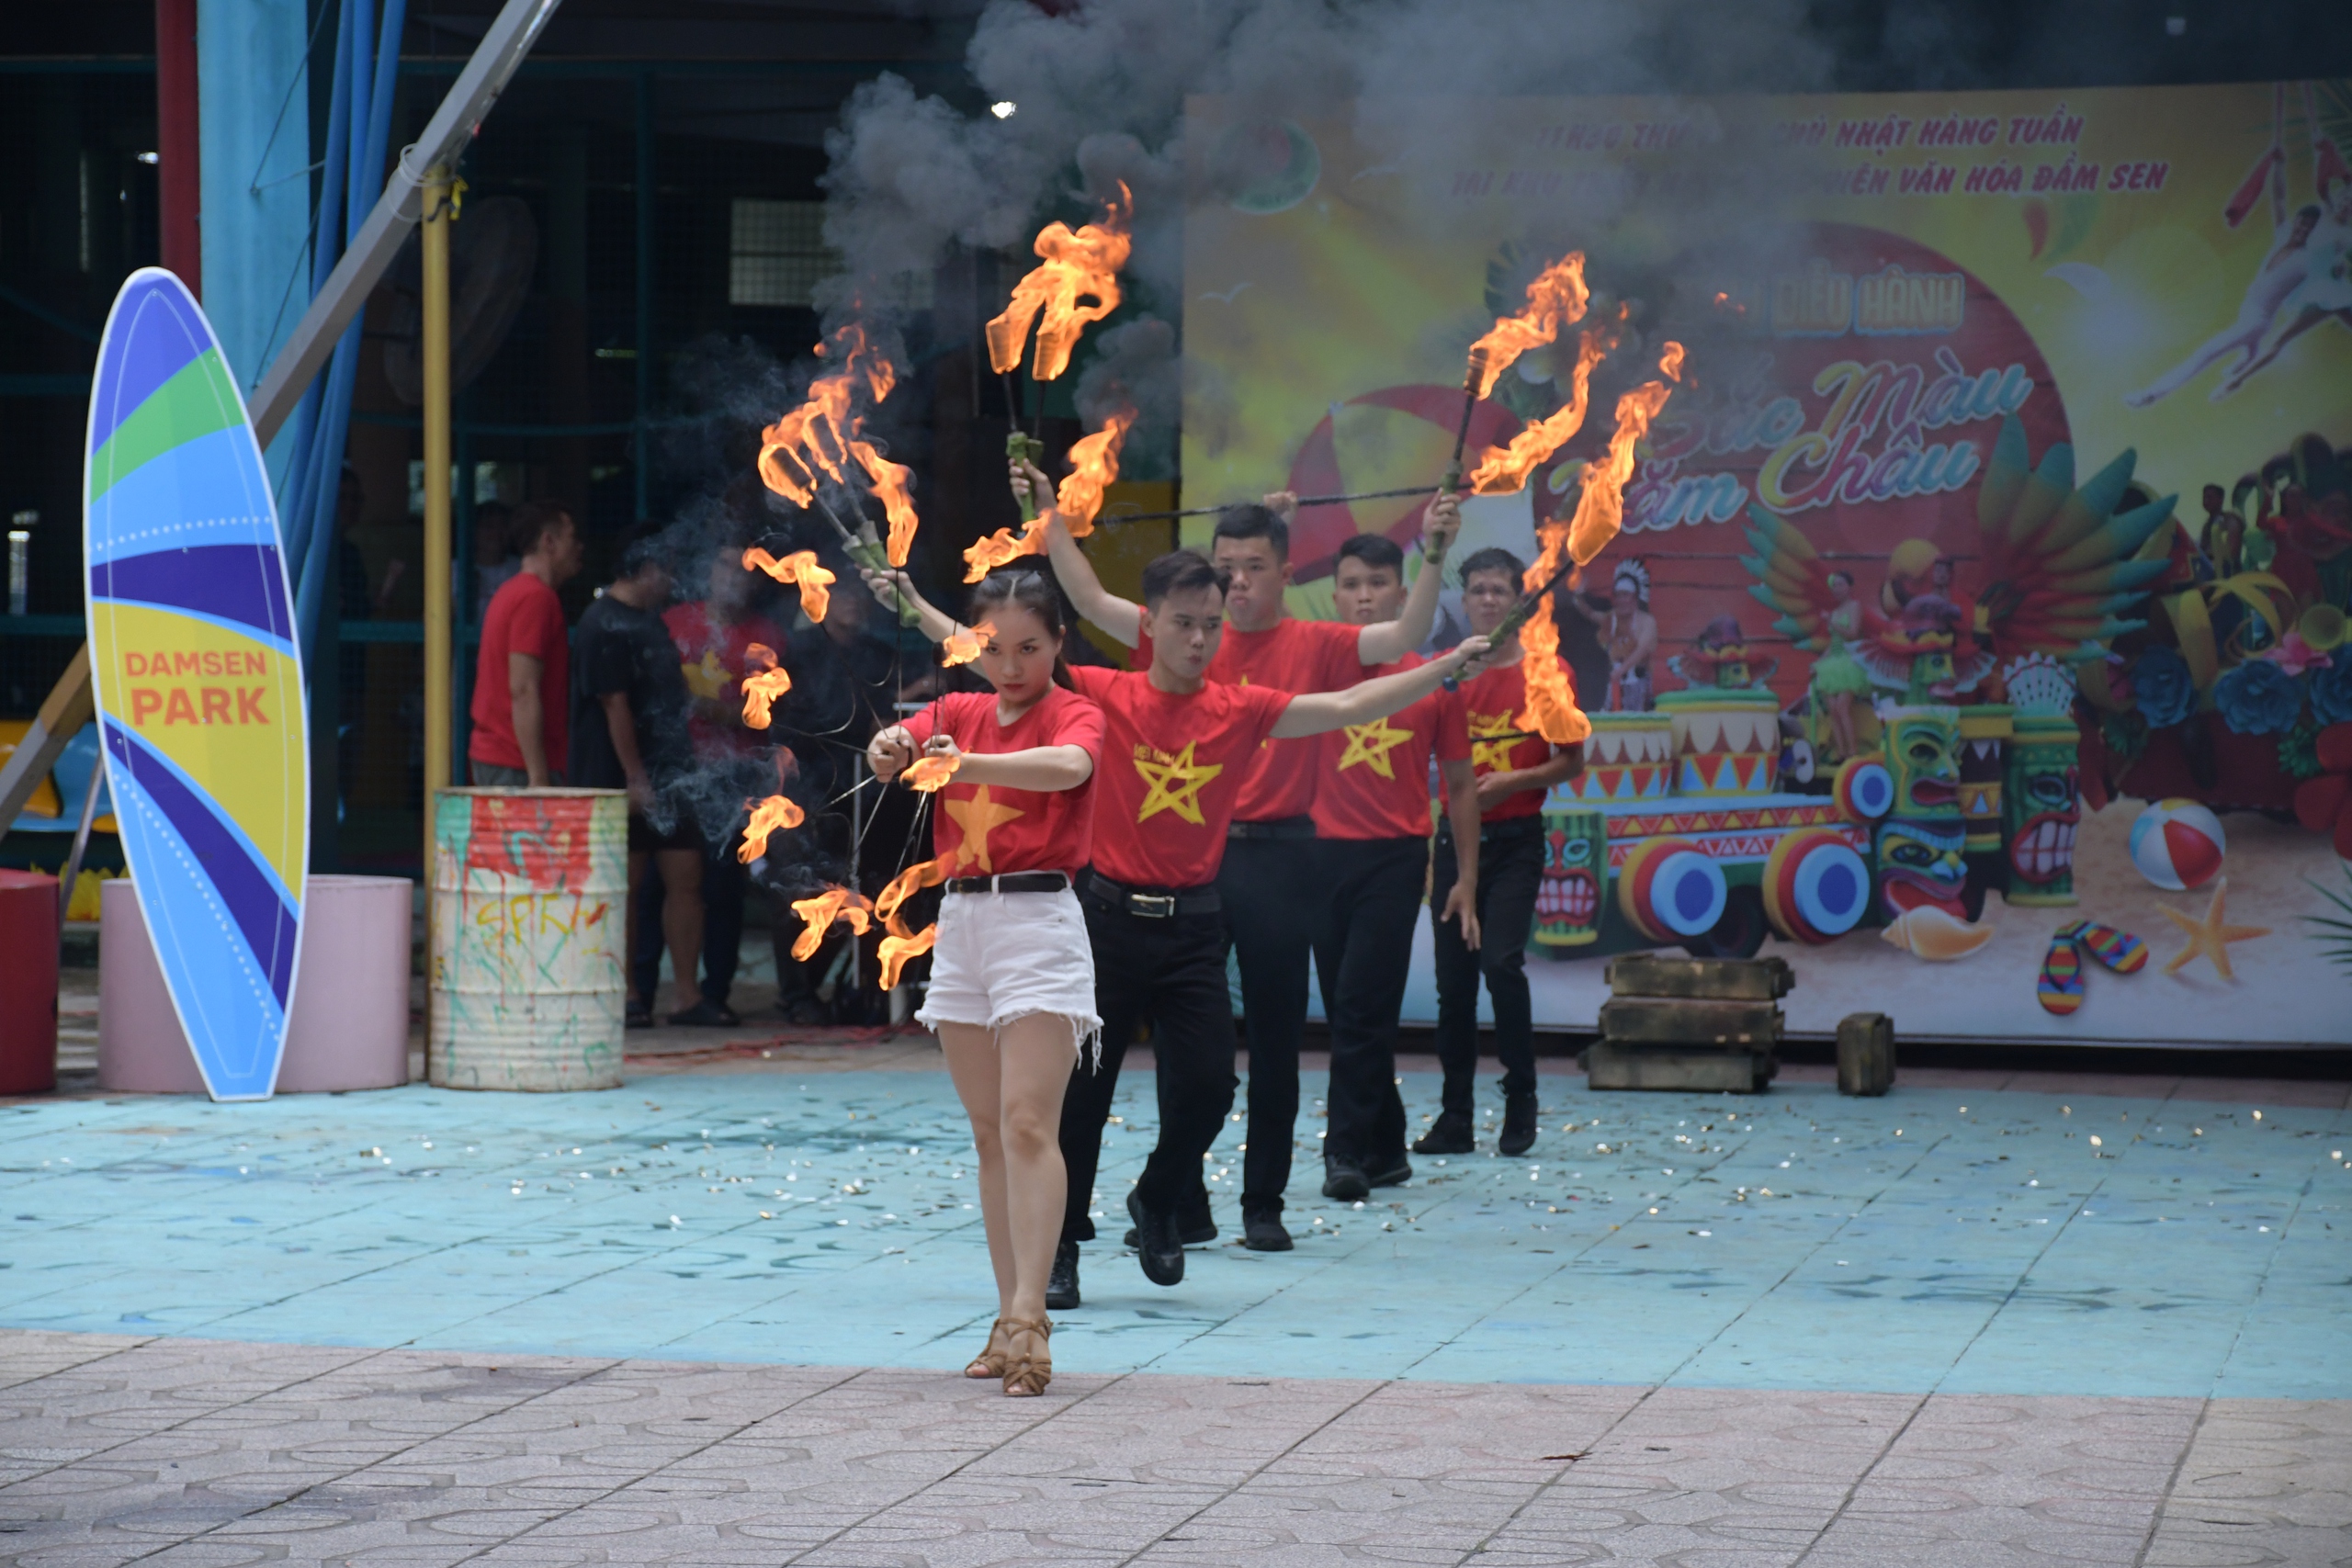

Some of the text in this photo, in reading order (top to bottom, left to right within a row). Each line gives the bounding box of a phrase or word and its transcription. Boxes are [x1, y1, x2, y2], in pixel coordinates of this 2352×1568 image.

[1835, 112, 1913, 157] NHẬT
[1917, 110, 1998, 147] HÀNG
[2007, 102, 2084, 145] TUẦN
[1898, 159, 1957, 195] VĂN
[1963, 157, 2025, 194] HÓA
[2030, 150, 2101, 193] ĐẦM
[2107, 162, 2169, 192] SEN
[1856, 266, 1963, 333] HÀNH
[1814, 346, 2034, 443] Màu
[1757, 420, 1982, 513] Châu
[124, 649, 266, 678] DAMSEN
[130, 685, 270, 727] PARK
